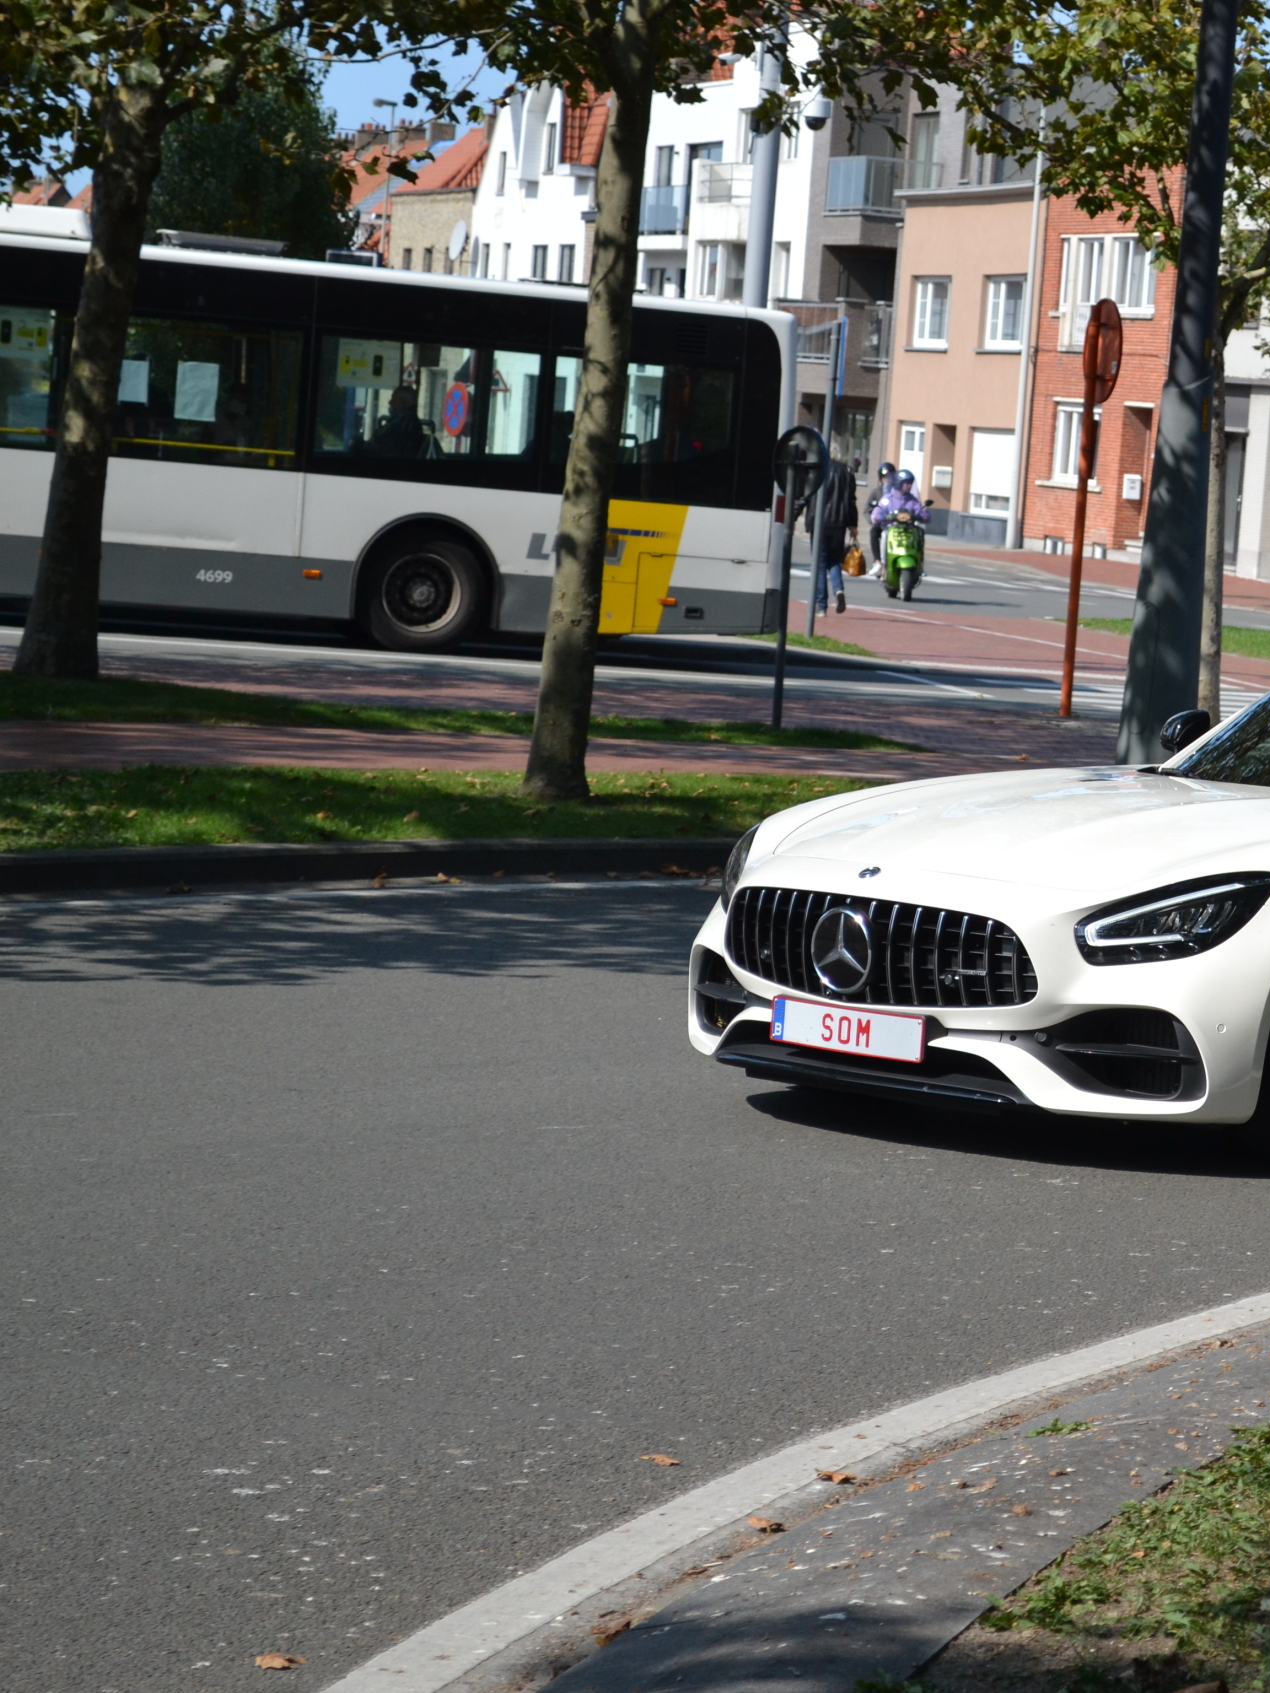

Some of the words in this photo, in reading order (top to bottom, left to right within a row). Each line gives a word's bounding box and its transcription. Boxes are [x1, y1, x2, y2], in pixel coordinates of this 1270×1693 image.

[196, 569, 233, 583] 4699
[774, 1022, 783, 1036] B
[821, 1013, 871, 1048] SOM
